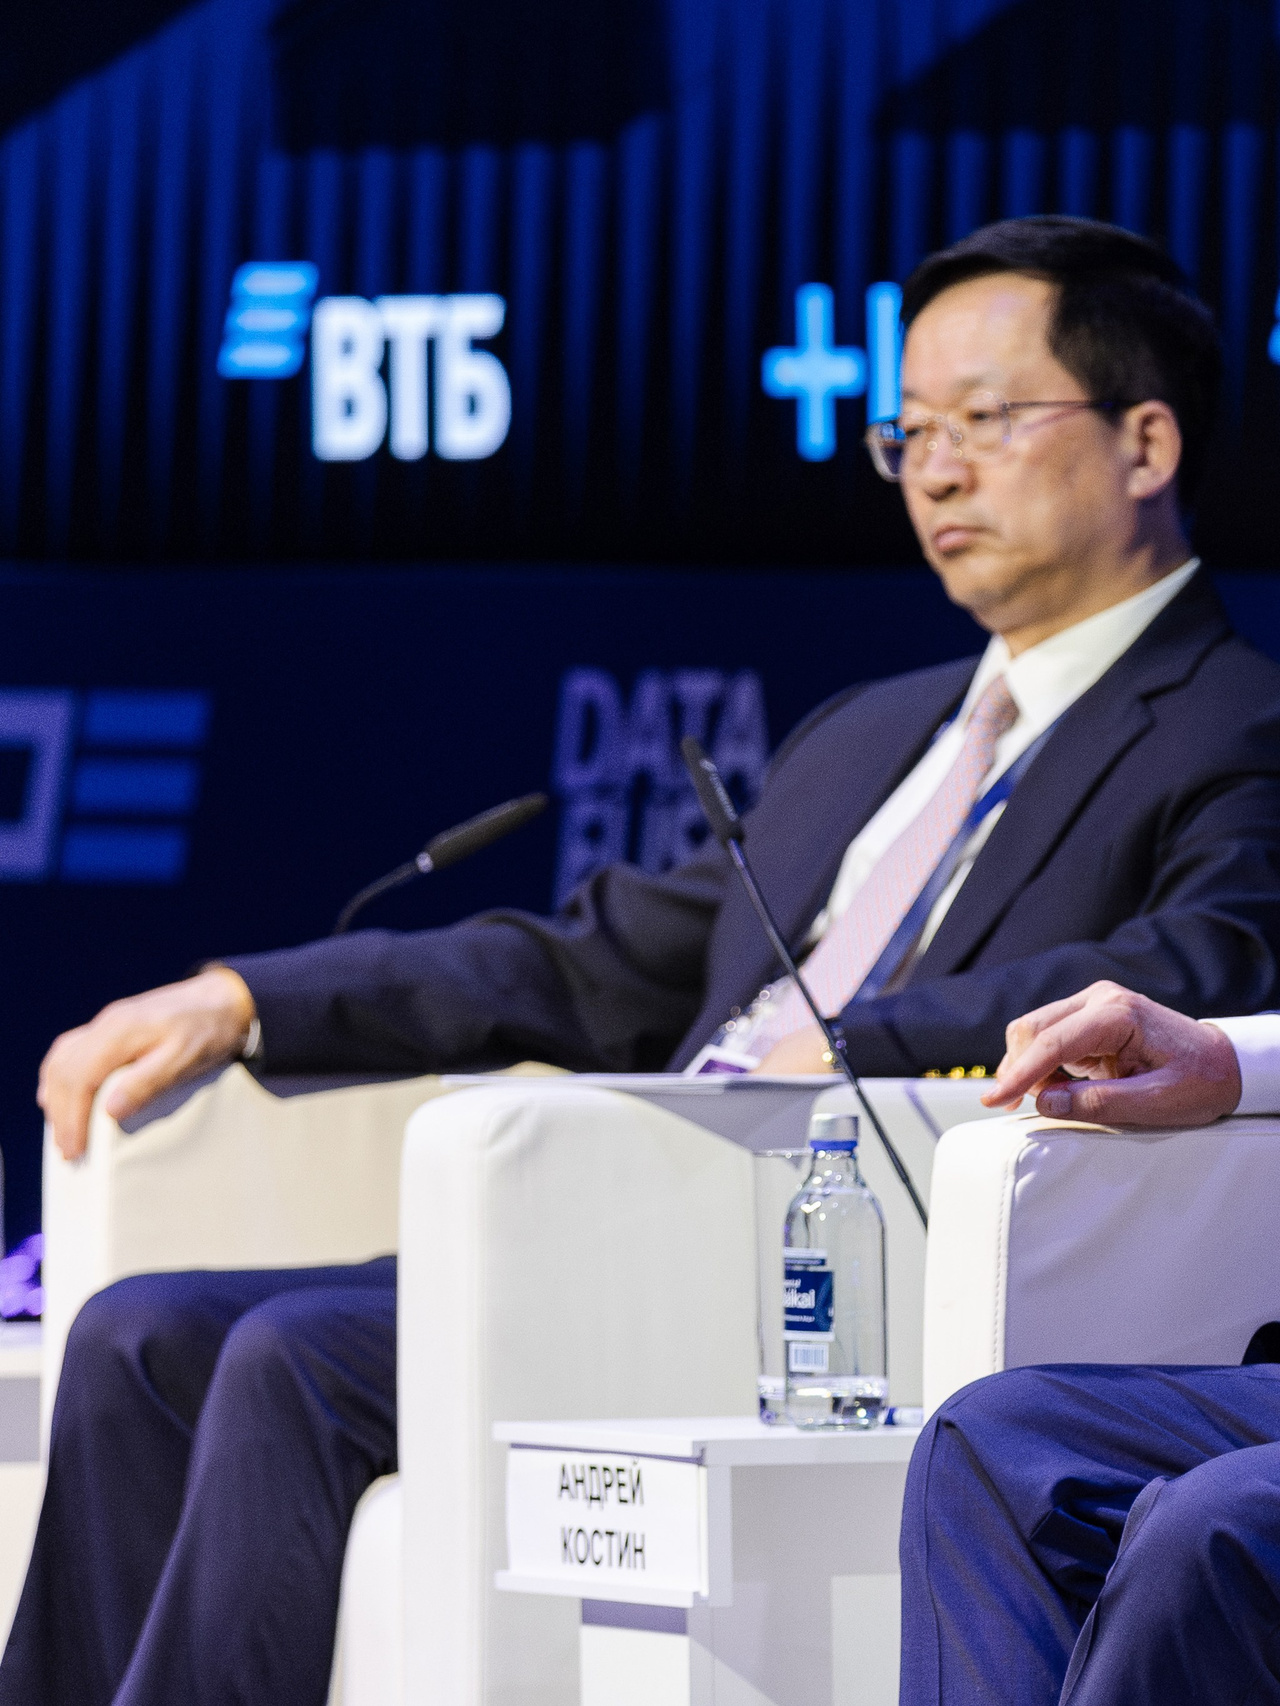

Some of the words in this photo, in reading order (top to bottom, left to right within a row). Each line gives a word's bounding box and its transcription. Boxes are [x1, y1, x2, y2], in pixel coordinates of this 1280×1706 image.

[311, 293, 512, 461] ВТБ
[556, 668, 768, 790] DATA
[558, 1456, 645, 1511] АНДРЕЙ
[561, 1527, 645, 1570] КОСТИН
